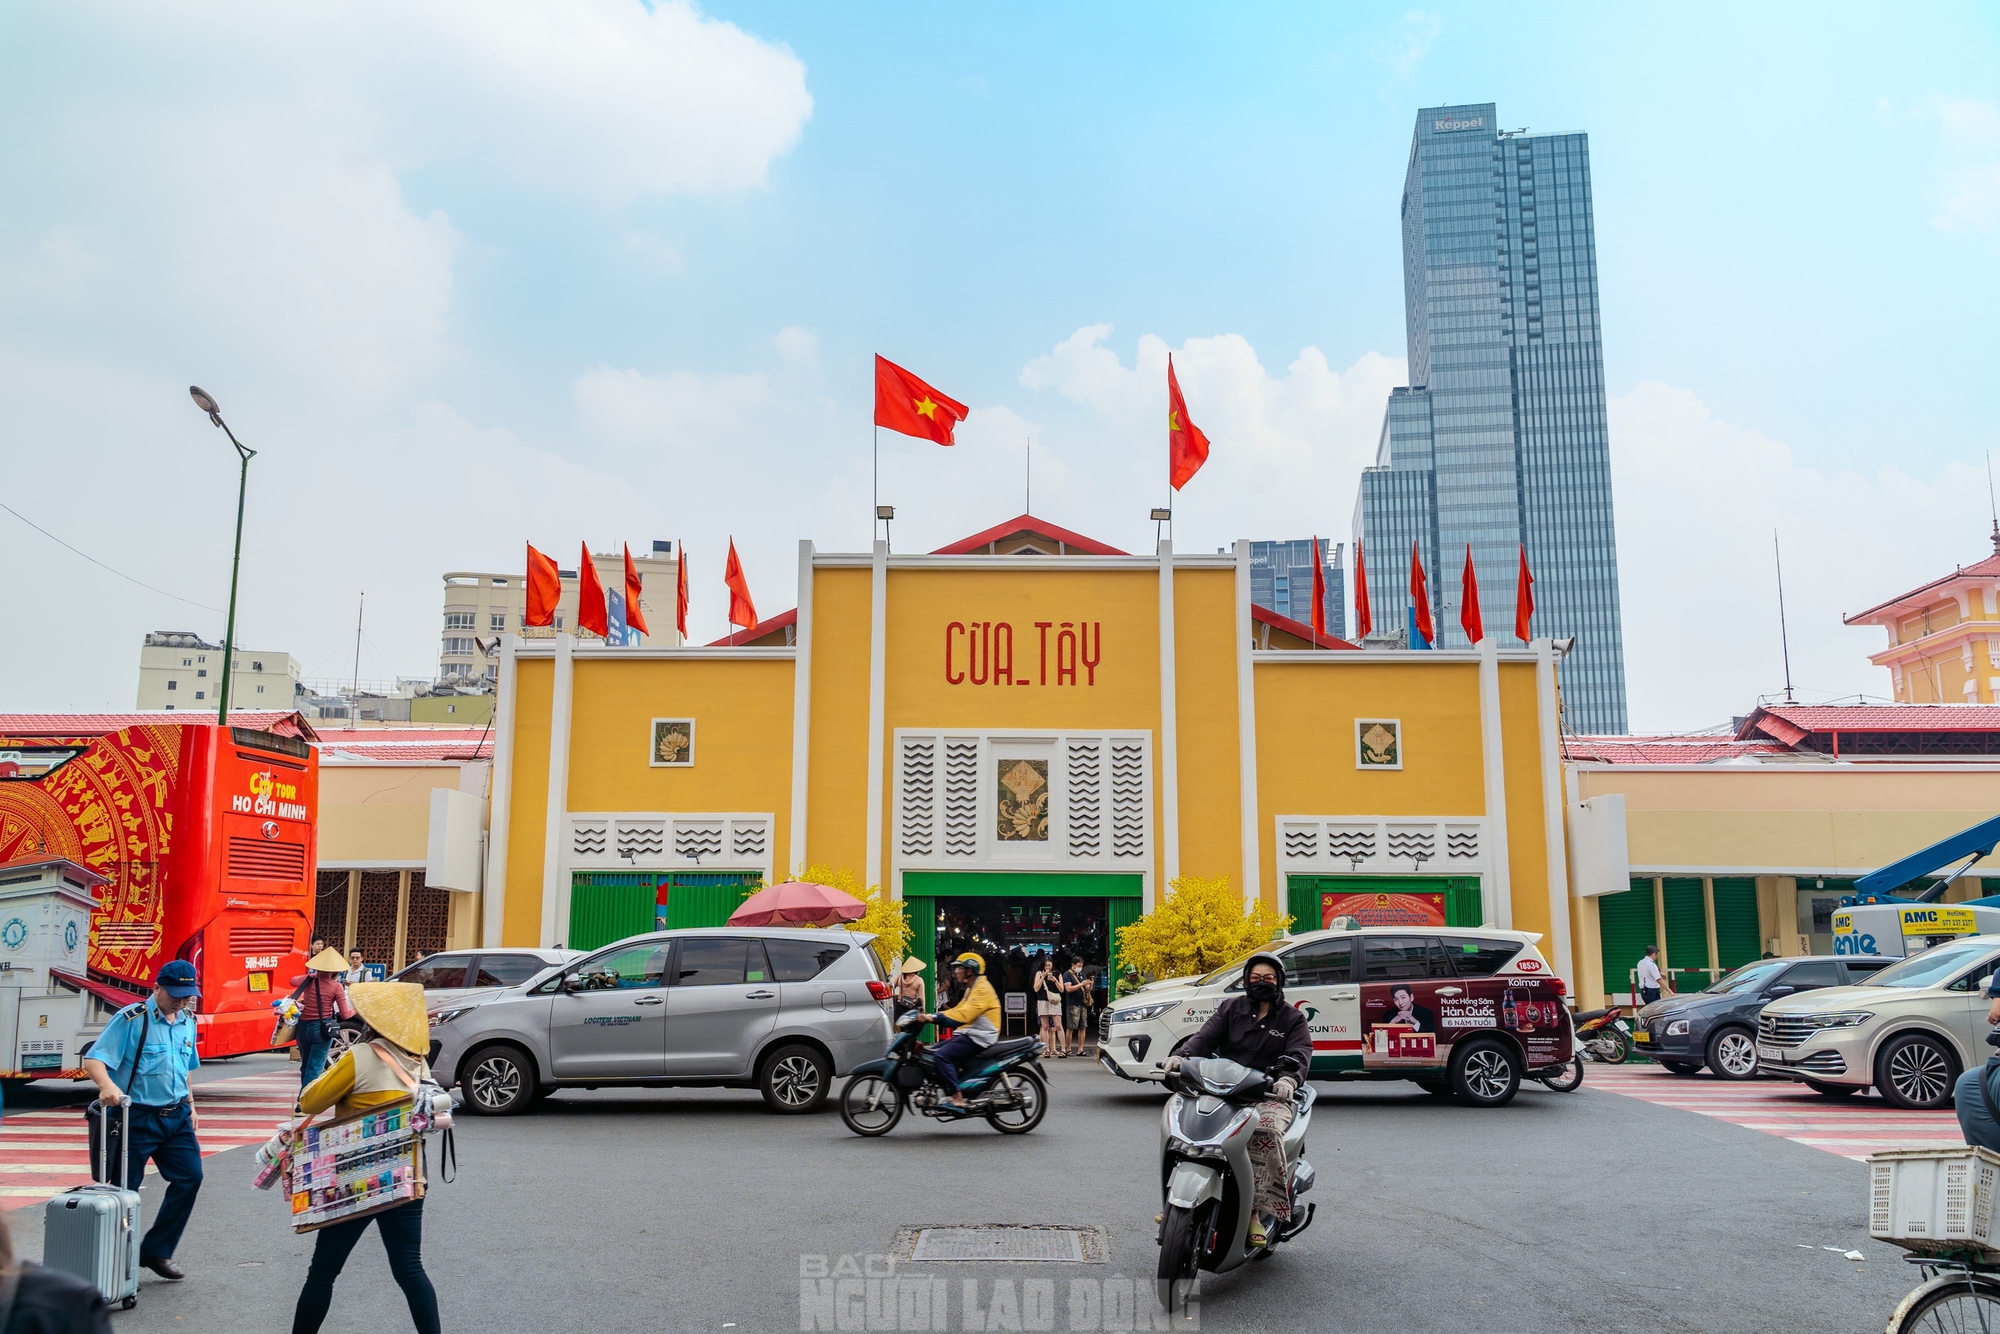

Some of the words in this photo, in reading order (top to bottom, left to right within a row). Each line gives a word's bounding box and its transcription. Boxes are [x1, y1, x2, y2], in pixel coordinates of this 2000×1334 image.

[1435, 116, 1482, 130] Keppel
[276, 783, 296, 799] TOUR
[232, 795, 252, 812] HO
[254, 799, 276, 816] CHI
[278, 802, 306, 820] MINH
[1835, 916, 1850, 928] AMC
[1904, 910, 1938, 924] AMC
[1833, 929, 1876, 956] enie
[1518, 961, 1540, 971] 18534
[1508, 978, 1540, 987] Kolmar
[1478, 997, 1494, 1005] Sâm
[1441, 1005, 1464, 1016] Hàn
[1466, 1005, 1495, 1016] Quốc
[1330, 1025, 1347, 1033] TAXI
